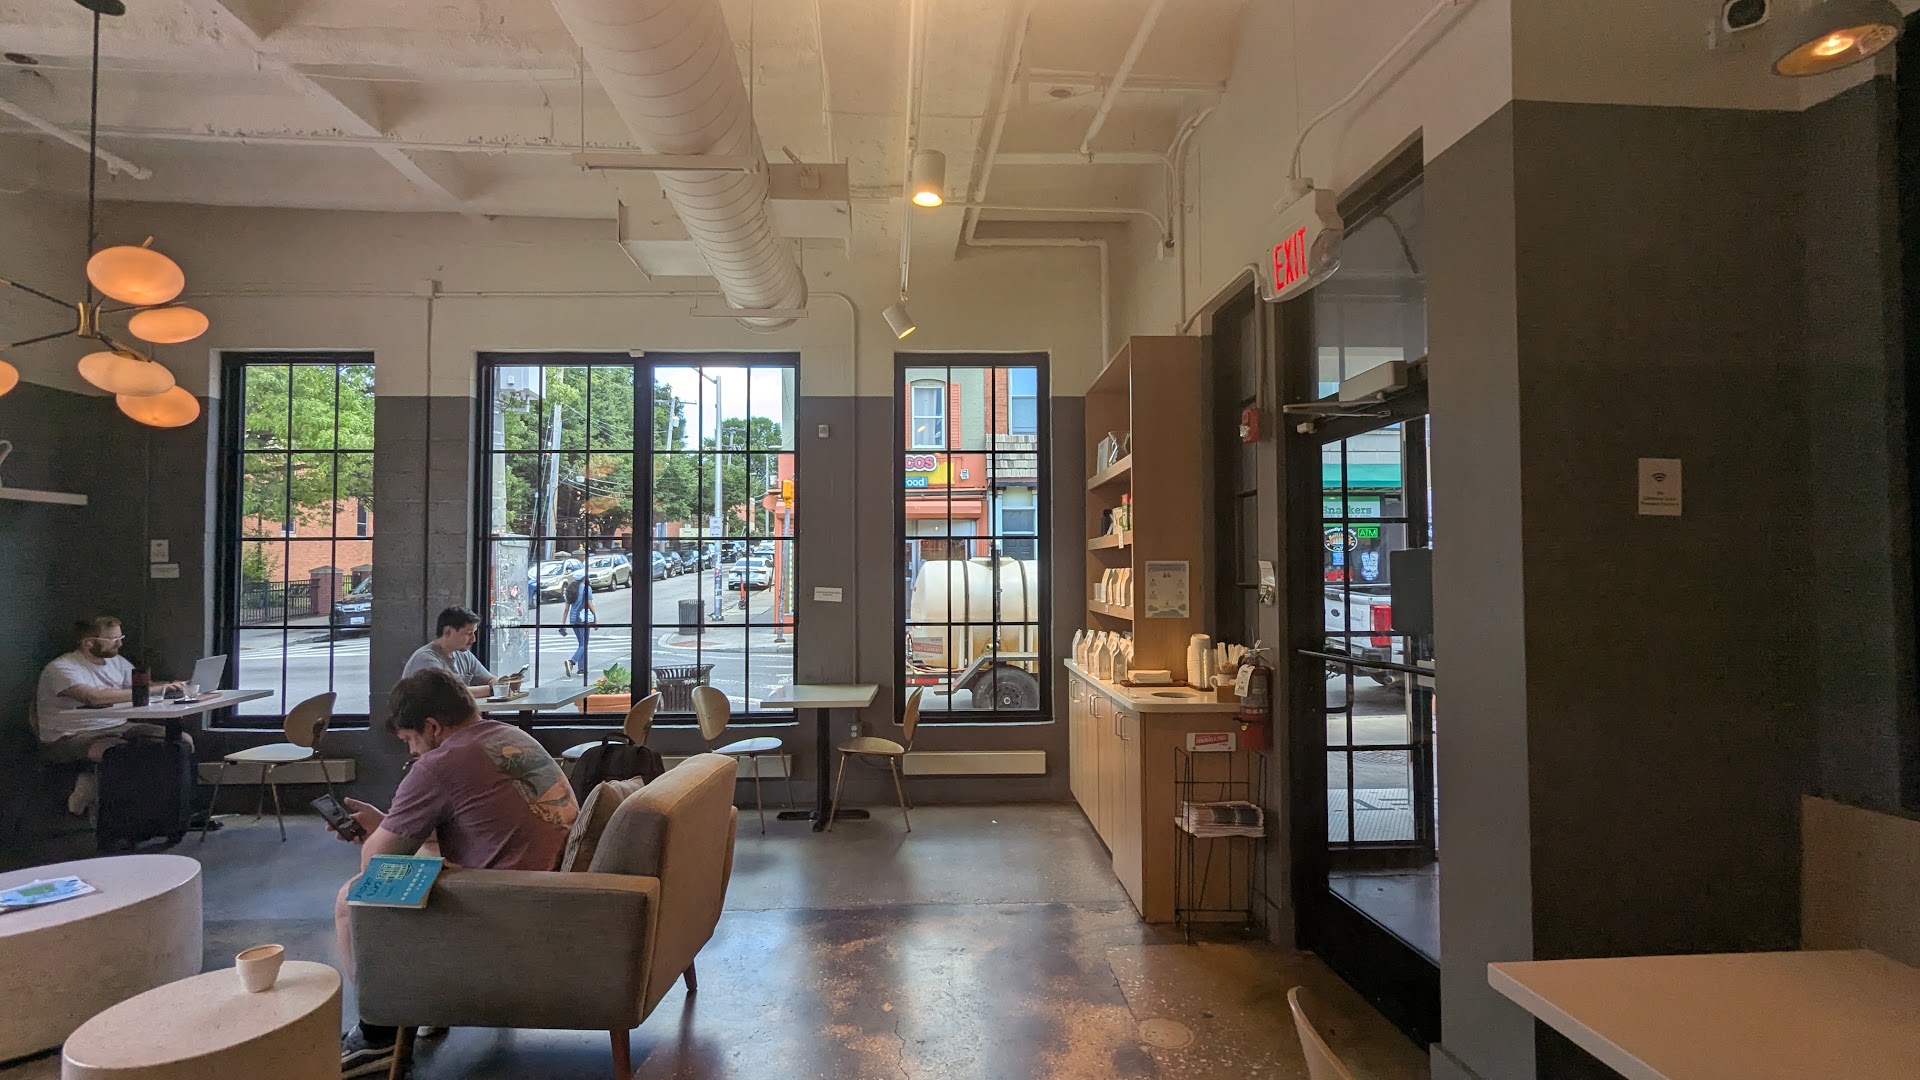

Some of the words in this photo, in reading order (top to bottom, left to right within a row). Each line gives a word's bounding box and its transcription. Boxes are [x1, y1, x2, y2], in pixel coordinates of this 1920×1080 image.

[1273, 226, 1307, 291] EXIT
[1323, 505, 1372, 514] Snakers
[1360, 529, 1376, 537] ATM
